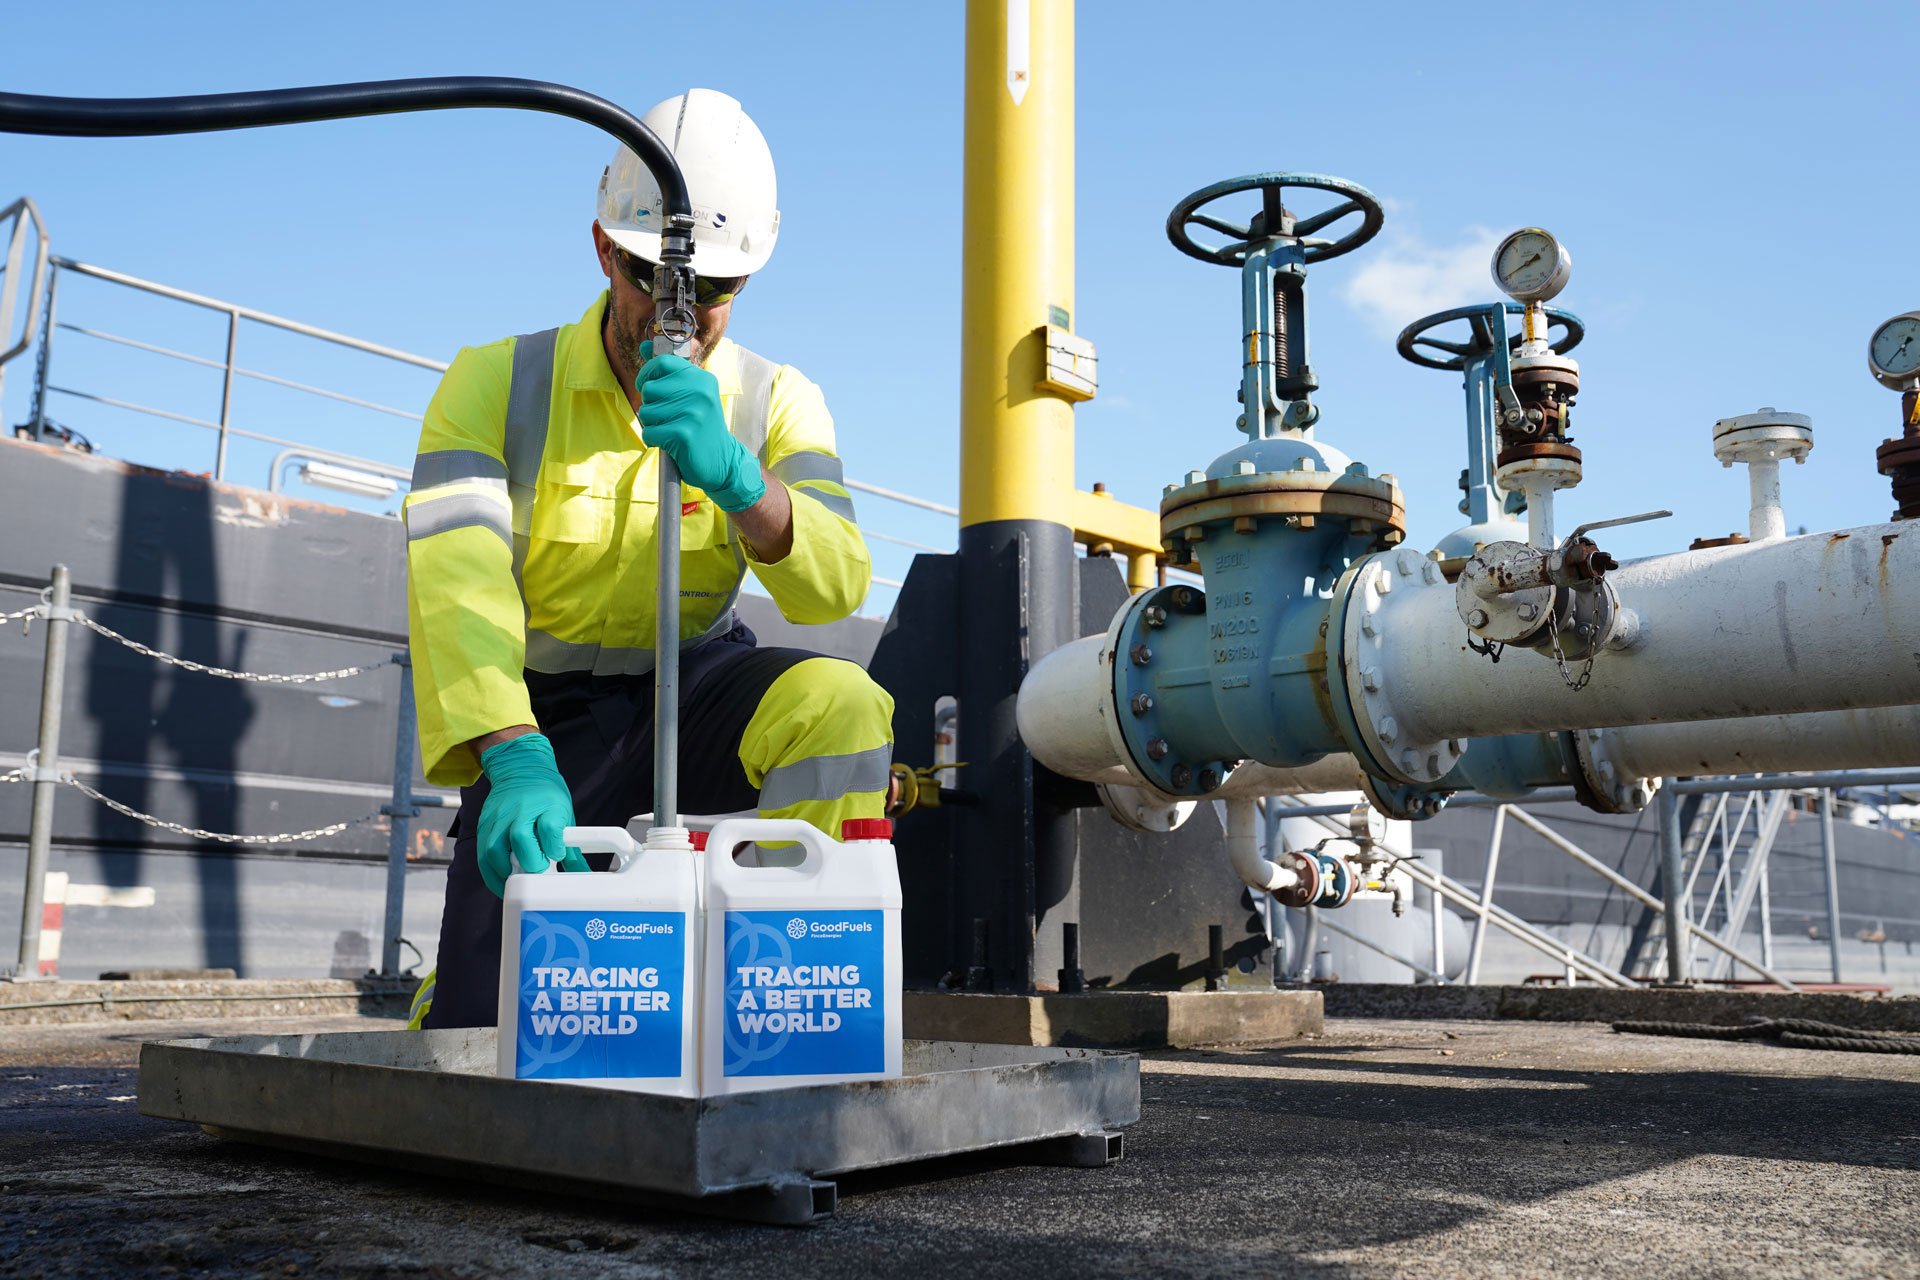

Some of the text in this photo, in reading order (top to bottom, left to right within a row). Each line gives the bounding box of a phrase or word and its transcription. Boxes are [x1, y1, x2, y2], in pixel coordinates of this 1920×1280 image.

[609, 922, 674, 934] GoodFuels
[810, 921, 873, 932] GoodFuels
[532, 967, 659, 988] TRACING
[736, 965, 861, 987] TRACING
[530, 990, 671, 1012] A BETTER
[736, 987, 872, 1011] A BETTER
[530, 1014, 638, 1036] WORLD
[736, 1011, 842, 1034] WORLD
